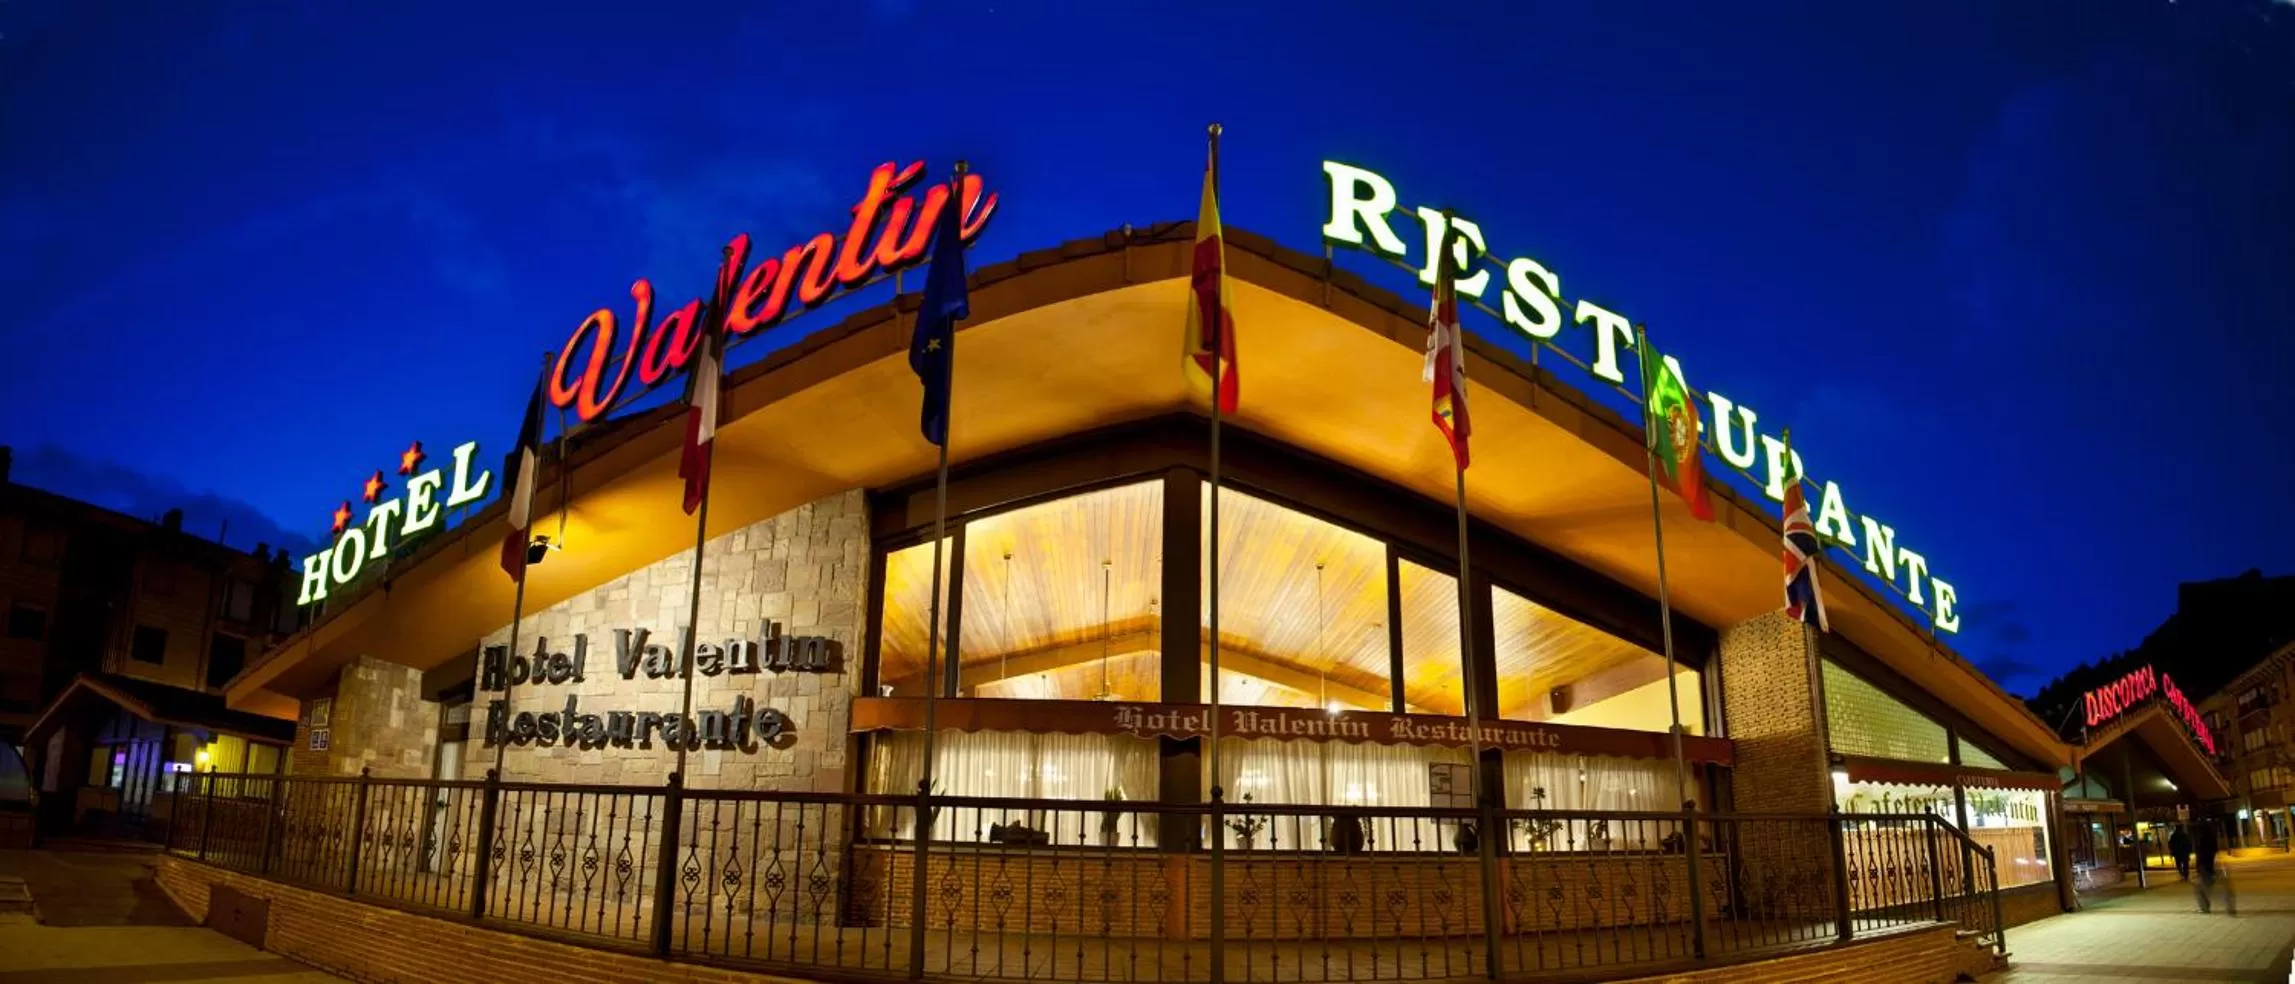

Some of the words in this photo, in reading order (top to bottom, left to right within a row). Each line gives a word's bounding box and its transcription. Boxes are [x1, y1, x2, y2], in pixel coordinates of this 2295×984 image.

[297, 441, 490, 605] HOTEL
[481, 633, 588, 692] Hotel
[484, 693, 794, 753] Restaurante
[1113, 706, 1211, 736] Hotel
[1232, 711, 1370, 738] Valentín
[1390, 716, 1561, 747] Restaurante
